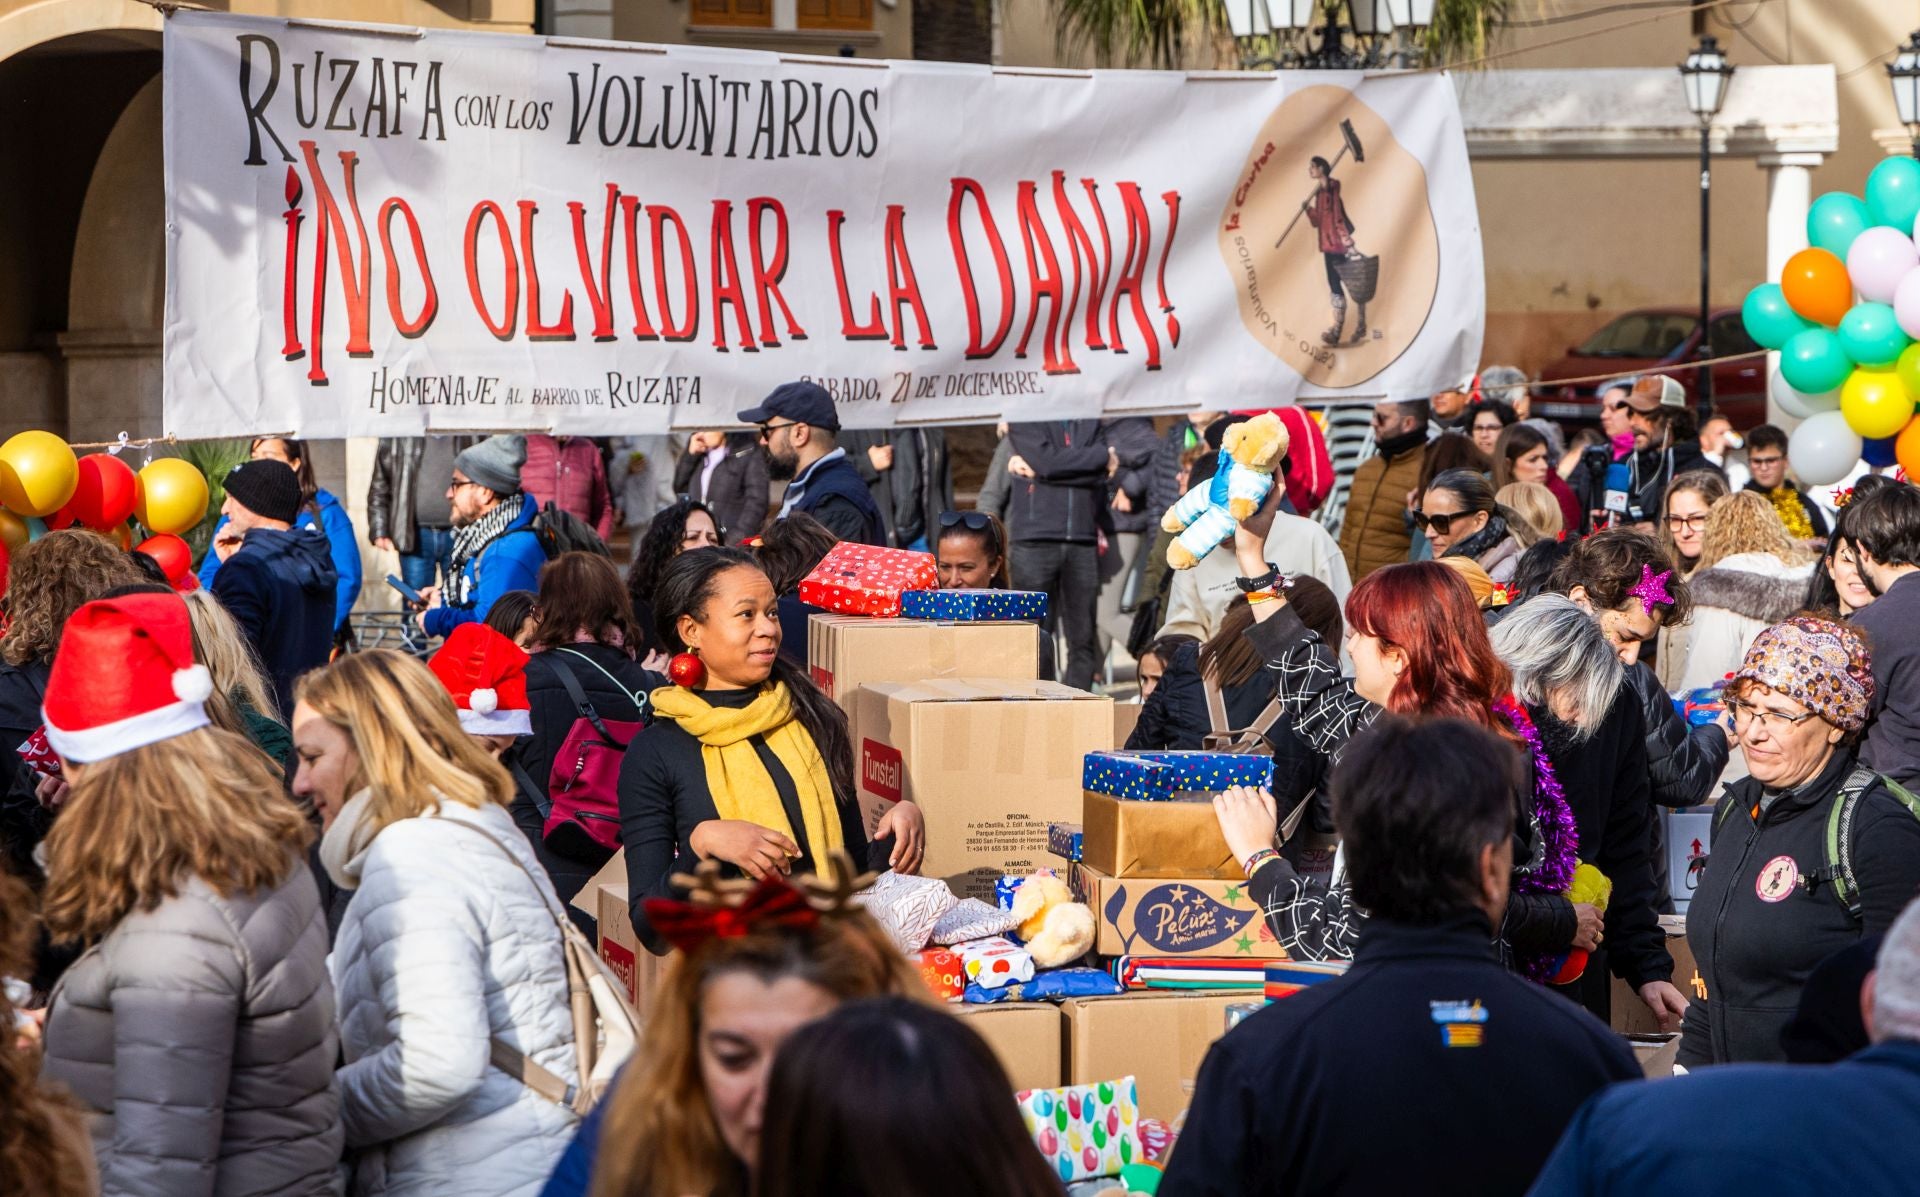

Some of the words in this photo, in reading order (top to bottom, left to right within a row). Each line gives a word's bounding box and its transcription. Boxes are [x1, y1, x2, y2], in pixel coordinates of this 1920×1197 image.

[236, 34, 447, 166] RUZAFA
[454, 94, 501, 129] CON
[505, 99, 553, 131] LOS
[567, 63, 879, 160] VOLUNTARIOS
[282, 140, 439, 387] ¡NO
[464, 183, 808, 353] OLVIDAR
[827, 204, 938, 351] LA
[947, 169, 1182, 376] DANA!
[1234, 235, 1279, 338] Voluntarios
[369, 366, 500, 414] HOMENAJE
[505, 386, 524, 406] AL
[531, 387, 581, 406] BARRIO
[584, 388, 604, 406] DE
[606, 371, 702, 410] RUZAFA
[891, 371, 912, 404] 21
[915, 375, 939, 399] DE
[944, 370, 1045, 397] DICIEMBRE
[864, 750, 900, 790] Tunstall
